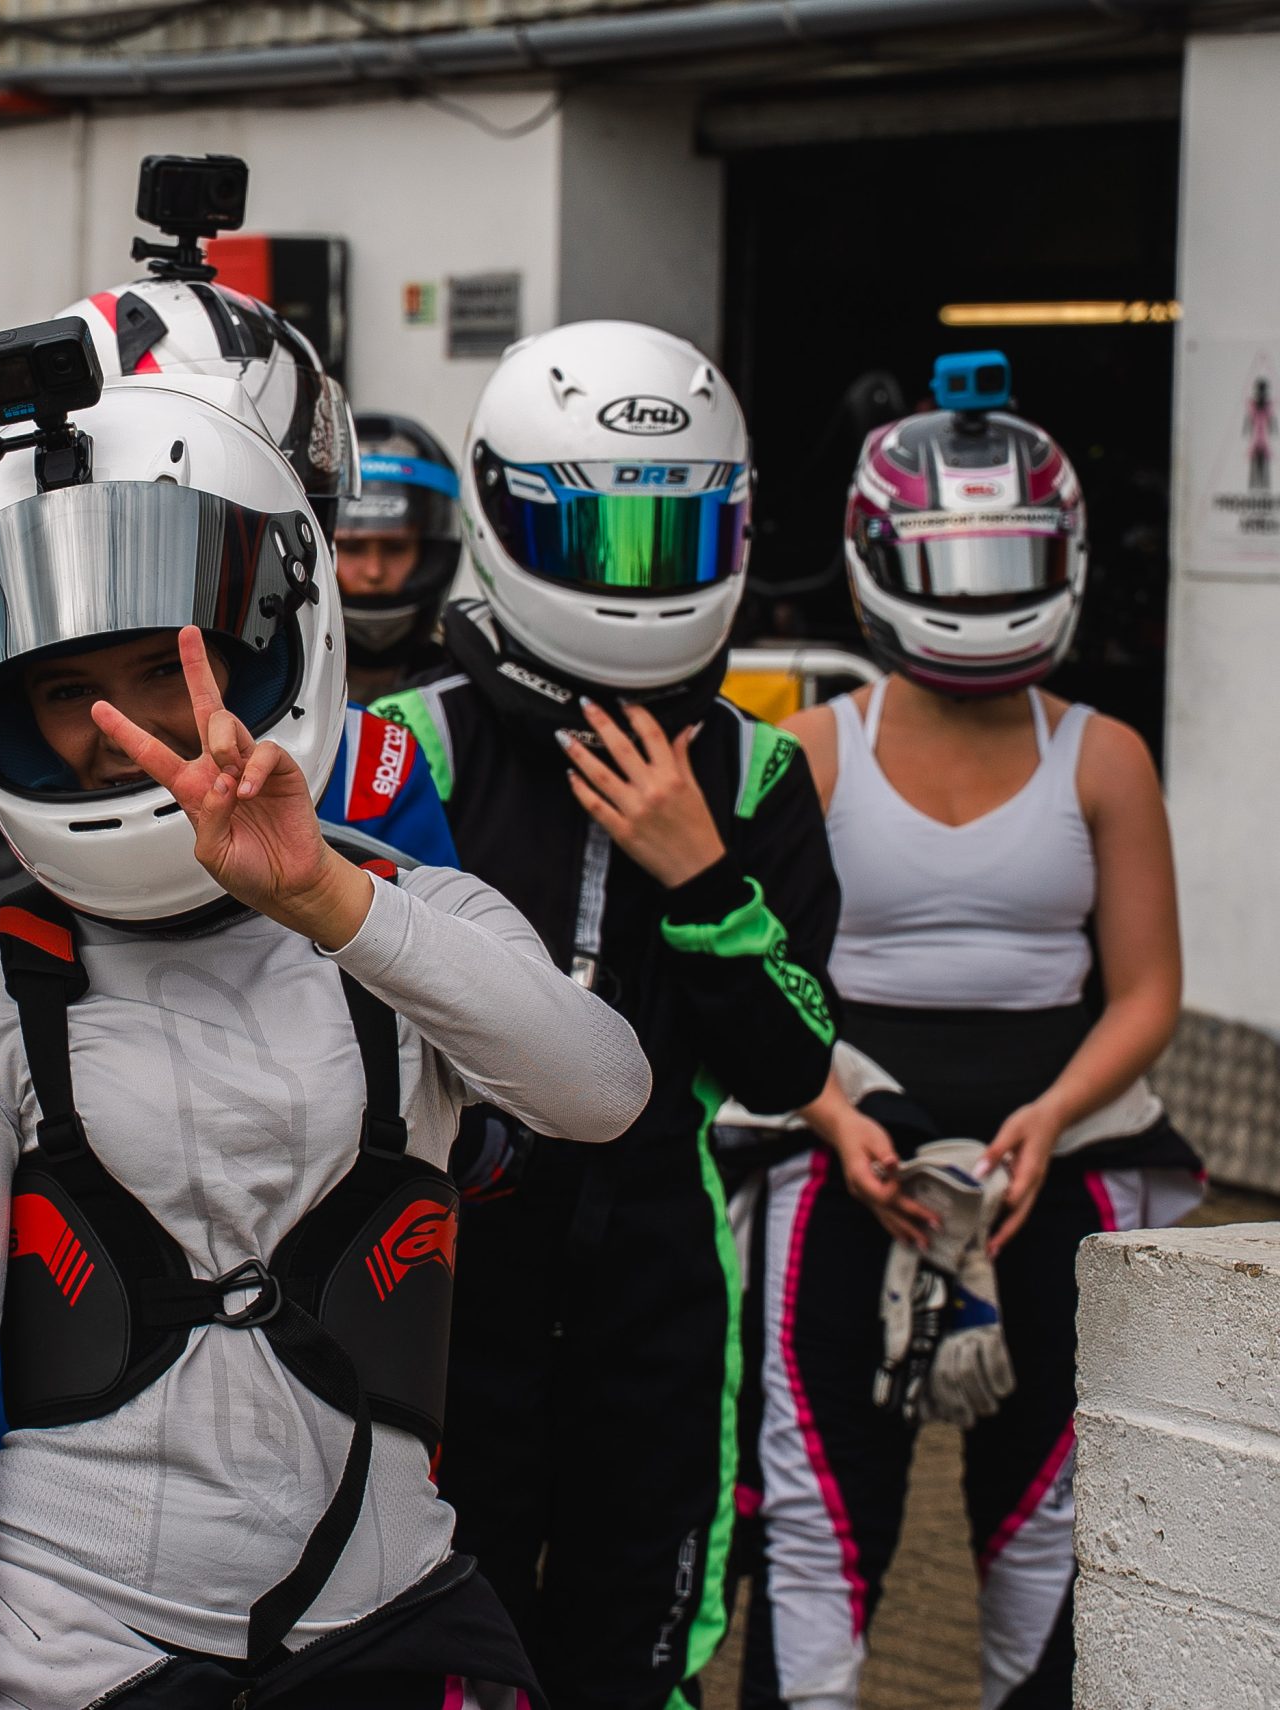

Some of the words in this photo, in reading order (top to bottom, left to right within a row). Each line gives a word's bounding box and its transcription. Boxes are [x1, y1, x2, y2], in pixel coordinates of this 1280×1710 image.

[604, 398, 680, 426] Arai
[613, 464, 691, 487] DRS
[497, 661, 572, 704] sparco
